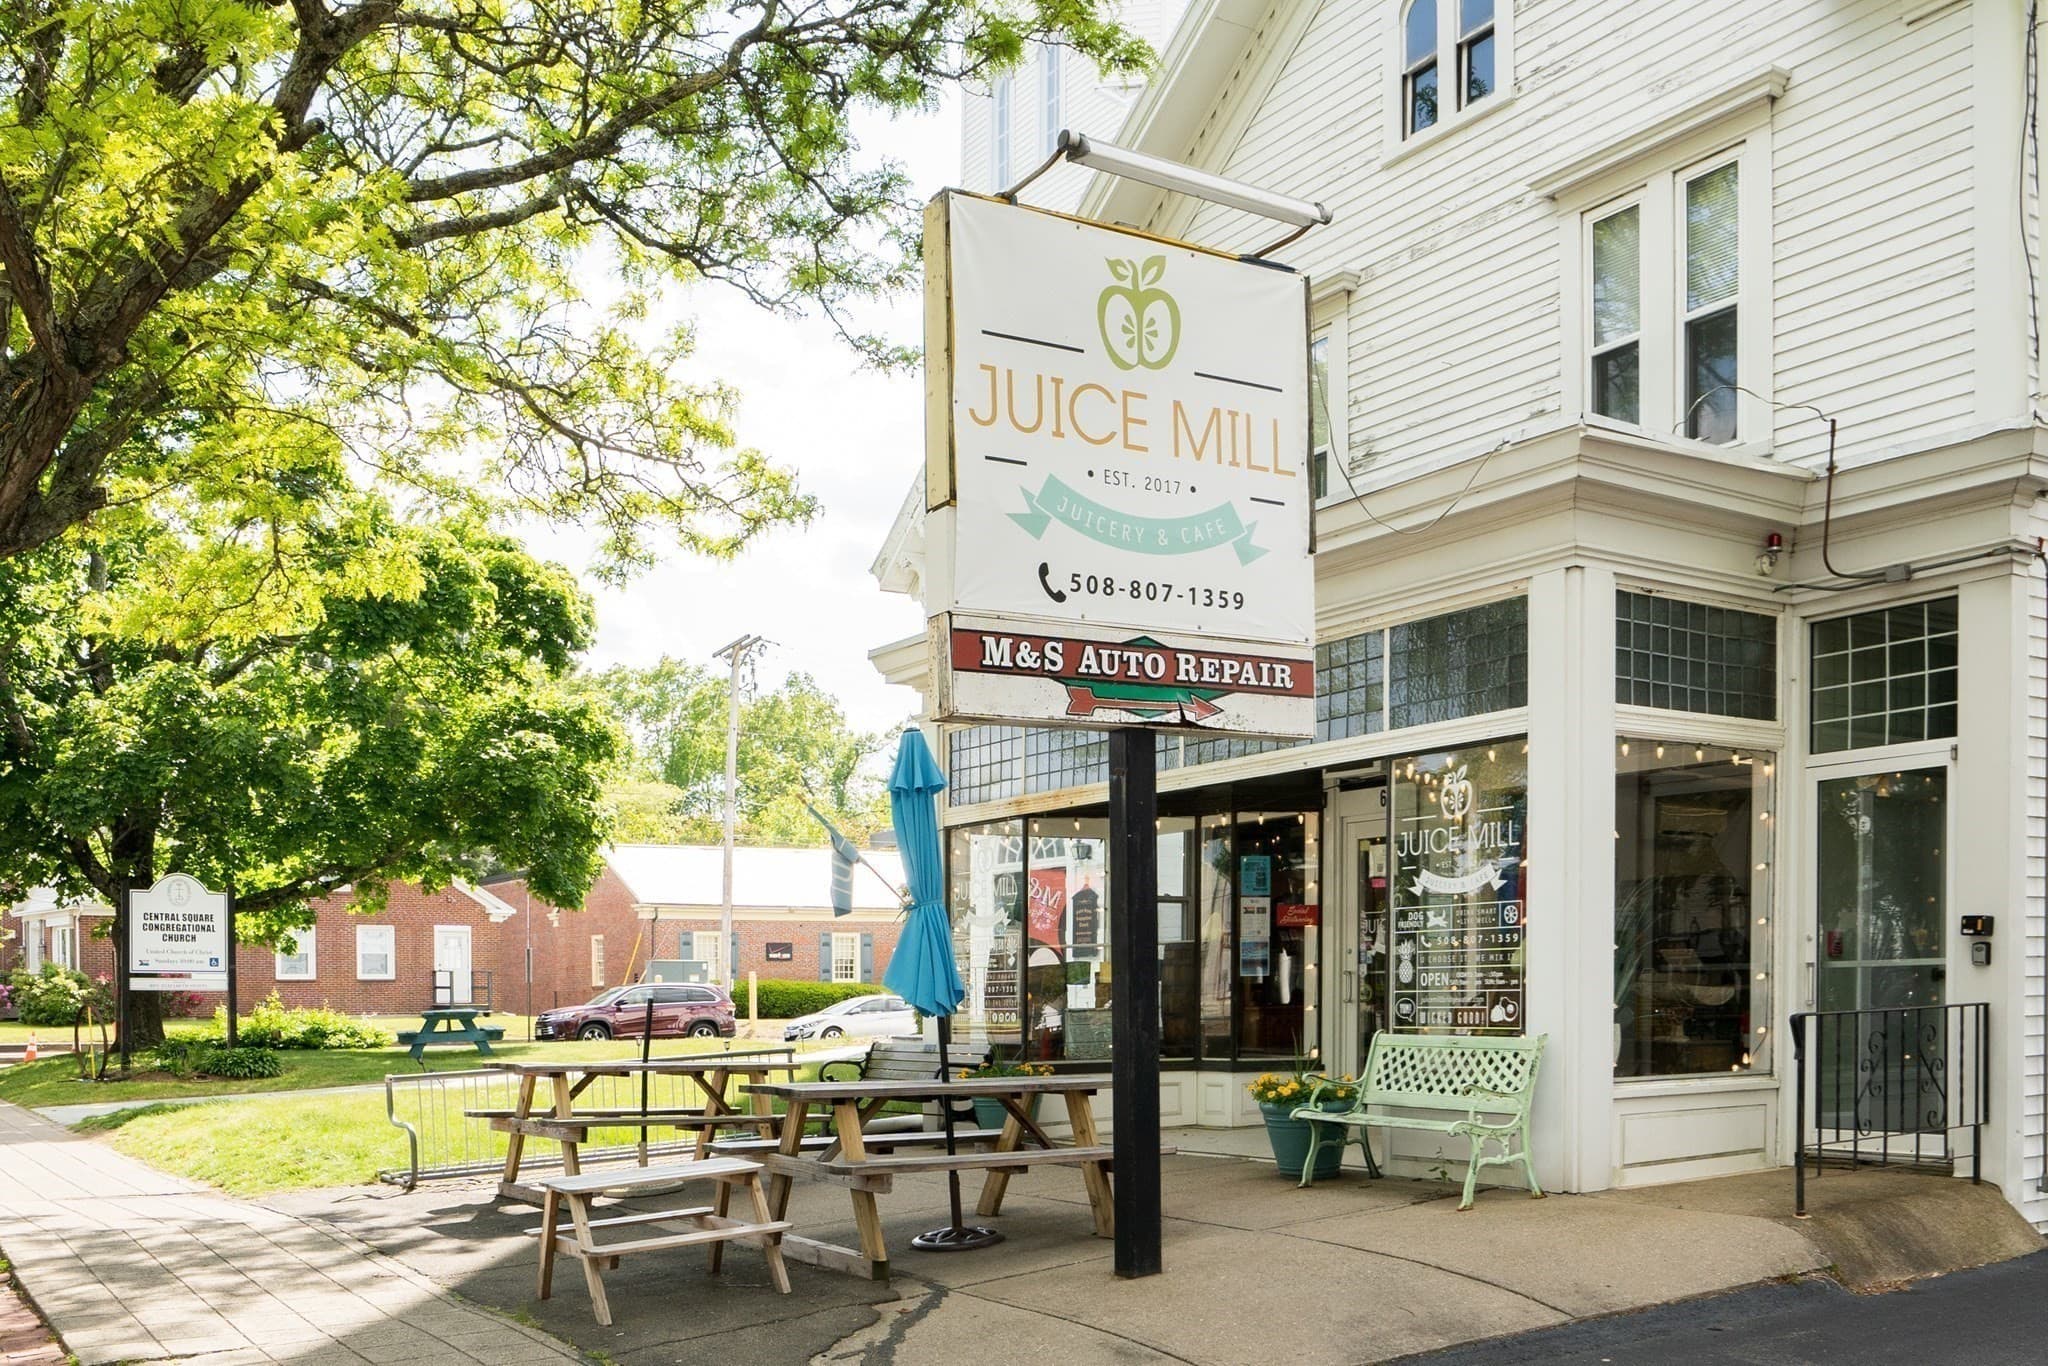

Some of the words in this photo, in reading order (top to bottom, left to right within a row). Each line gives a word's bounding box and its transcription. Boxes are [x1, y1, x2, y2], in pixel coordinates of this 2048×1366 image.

[968, 363, 1148, 453] JUICE
[1173, 400, 1296, 477] MILL
[1104, 469, 1135, 489] EST.
[1144, 476, 1181, 495] 2017
[1056, 496, 1145, 544] JUICERY
[1158, 528, 1169, 546] &
[1180, 518, 1226, 545] CAFE
[1069, 573, 1245, 610] 508-807-1359
[981, 635, 1064, 673] M&S
[1078, 645, 1166, 679] AUTO
[1175, 653, 1295, 690] REPAIR
[1397, 826, 1460, 857] JUICE
[1468, 820, 1521, 849] MILL
[143, 912, 180, 922] CENTRAL
[182, 913, 214, 923] SQUARE
[1408, 911, 1424, 921] DOG
[142, 923, 216, 933] CONGREGATIONAL
[1397, 920, 1424, 930] FRIENDLY
[162, 933, 197, 943] CHURCH
[1436, 933, 1519, 946] 508-807-1359
[1420, 972, 1449, 986] OPEN
[1419, 1011, 1453, 1024] WICKED
[1457, 1011, 1485, 1024] GOOD!
